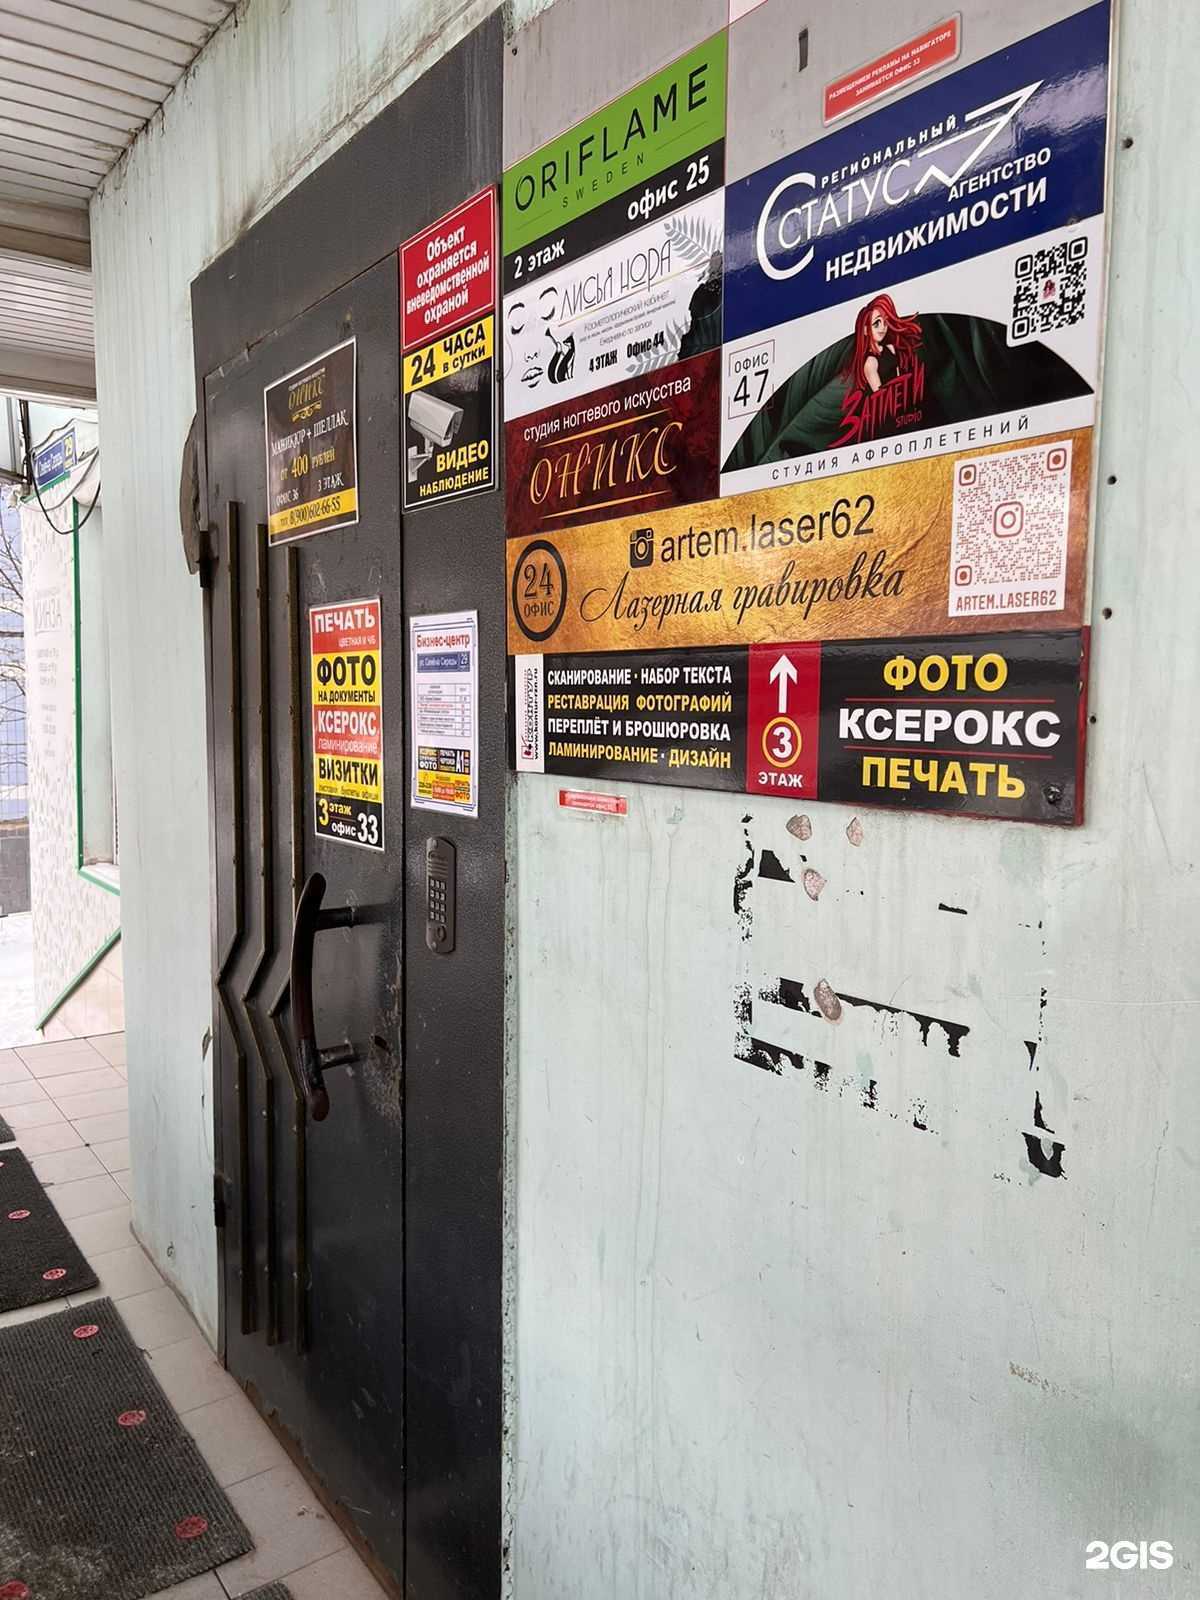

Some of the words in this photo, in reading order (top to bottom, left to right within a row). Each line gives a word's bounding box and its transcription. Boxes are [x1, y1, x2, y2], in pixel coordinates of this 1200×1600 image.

[872, 57, 901, 81] РЕКЛАМЫ
[901, 51, 910, 62] НА
[911, 30, 952, 59] НАВИГАТОРЕ
[855, 71, 894, 97] ЗАНИМАЕТСЯ
[894, 62, 912, 78] ОФИС
[514, 63, 708, 212] ORIFLAME
[821, 114, 957, 188] РЕГИОНАЛЬНЫЙ
[562, 152, 644, 208] SWEDEN
[948, 147, 1052, 202] АГЕНТСТВО
[513, 257, 523, 280] 2
[527, 238, 566, 272] этаж
[627, 179, 679, 221] офис
[686, 154, 710, 192] 25
[778, 158, 912, 249] СТАТУС
[426, 225, 466, 262] Объект
[825, 177, 1048, 282] НЕДВИЖИМОСТИ
[406, 250, 490, 316] вневедомственной
[416, 240, 478, 289] охраняется
[559, 267, 614, 320] ЛИСЬЯ
[620, 239, 672, 293] НОРА
[424, 284, 469, 325] охраной
[410, 348, 436, 386] 24
[442, 323, 486, 356] ЧАСА
[442, 360, 449, 374] в
[452, 344, 486, 370] сутки
[588, 357, 595, 373] 4
[595, 349, 618, 372] ЭТАЖ
[626, 337, 652, 358] ОФИС
[652, 330, 666, 348] 44
[734, 352, 769, 374] ОФИС
[563, 400, 621, 427] ногтевого
[624, 376, 691, 411] искусства
[732, 368, 770, 408] 47
[826, 358, 925, 448] ЗАПЛЕТИ
[271, 429, 306, 457] МАНИКЮР
[313, 409, 350, 441] ШЕЛЛАК
[772, 456, 840, 480] СТУДИЯ
[851, 414, 1030, 464] АФРОПЛЕТЕНИЙ
[290, 454, 310, 479] 400
[436, 439, 490, 474] ВИДЕО
[530, 422, 684, 505] ОНИКС
[324, 472, 345, 489] ЭТАЖ
[419, 466, 490, 497] НАБЛЮДЕНИЕ
[660, 494, 876, 563] artem.laser62
[523, 562, 555, 599] 24
[580, 570, 724, 632] Лазерная
[732, 550, 906, 624] гравировка
[524, 600, 555, 618] ОФИС
[956, 590, 1058, 612] ARTEM.LASER62
[314, 607, 376, 634] ПЕЧАТЬ
[416, 634, 470, 648] Бизнес-центр
[316, 654, 376, 686] ФОТО
[547, 668, 632, 686] СКАНИРОВАНИЕ
[641, 668, 680, 684] НАБОР
[683, 666, 732, 684] ТЕКСТА
[882, 653, 1008, 692] ФОТО
[318, 690, 328, 702] НА
[329, 690, 376, 705] ДОКУМЕНТЫ
[547, 694, 630, 713] РЕСТАВРАЦИЯ
[636, 691, 732, 713] ФОТОГРАФИЙ
[317, 710, 377, 737] КСЕРОКС
[548, 716, 609, 736] ПЕРЕПЛЁТ
[612, 720, 622, 736] И
[625, 720, 731, 742] БРОШЮРОВКА
[838, 707, 1061, 748] КСЕРОКС
[548, 742, 658, 764] ЛАМИНИРОВАНИЕ
[668, 747, 731, 769] ДИЗАЙН
[772, 726, 793, 760] 3
[318, 758, 378, 786] ВИЗИТКИ
[758, 771, 804, 788] ЭТАЖ
[862, 756, 1026, 800] ПЕЧАТЬ
[318, 798, 329, 826] 3
[329, 802, 352, 816] этаж
[331, 820, 356, 837] офис
[357, 812, 379, 844] 33
